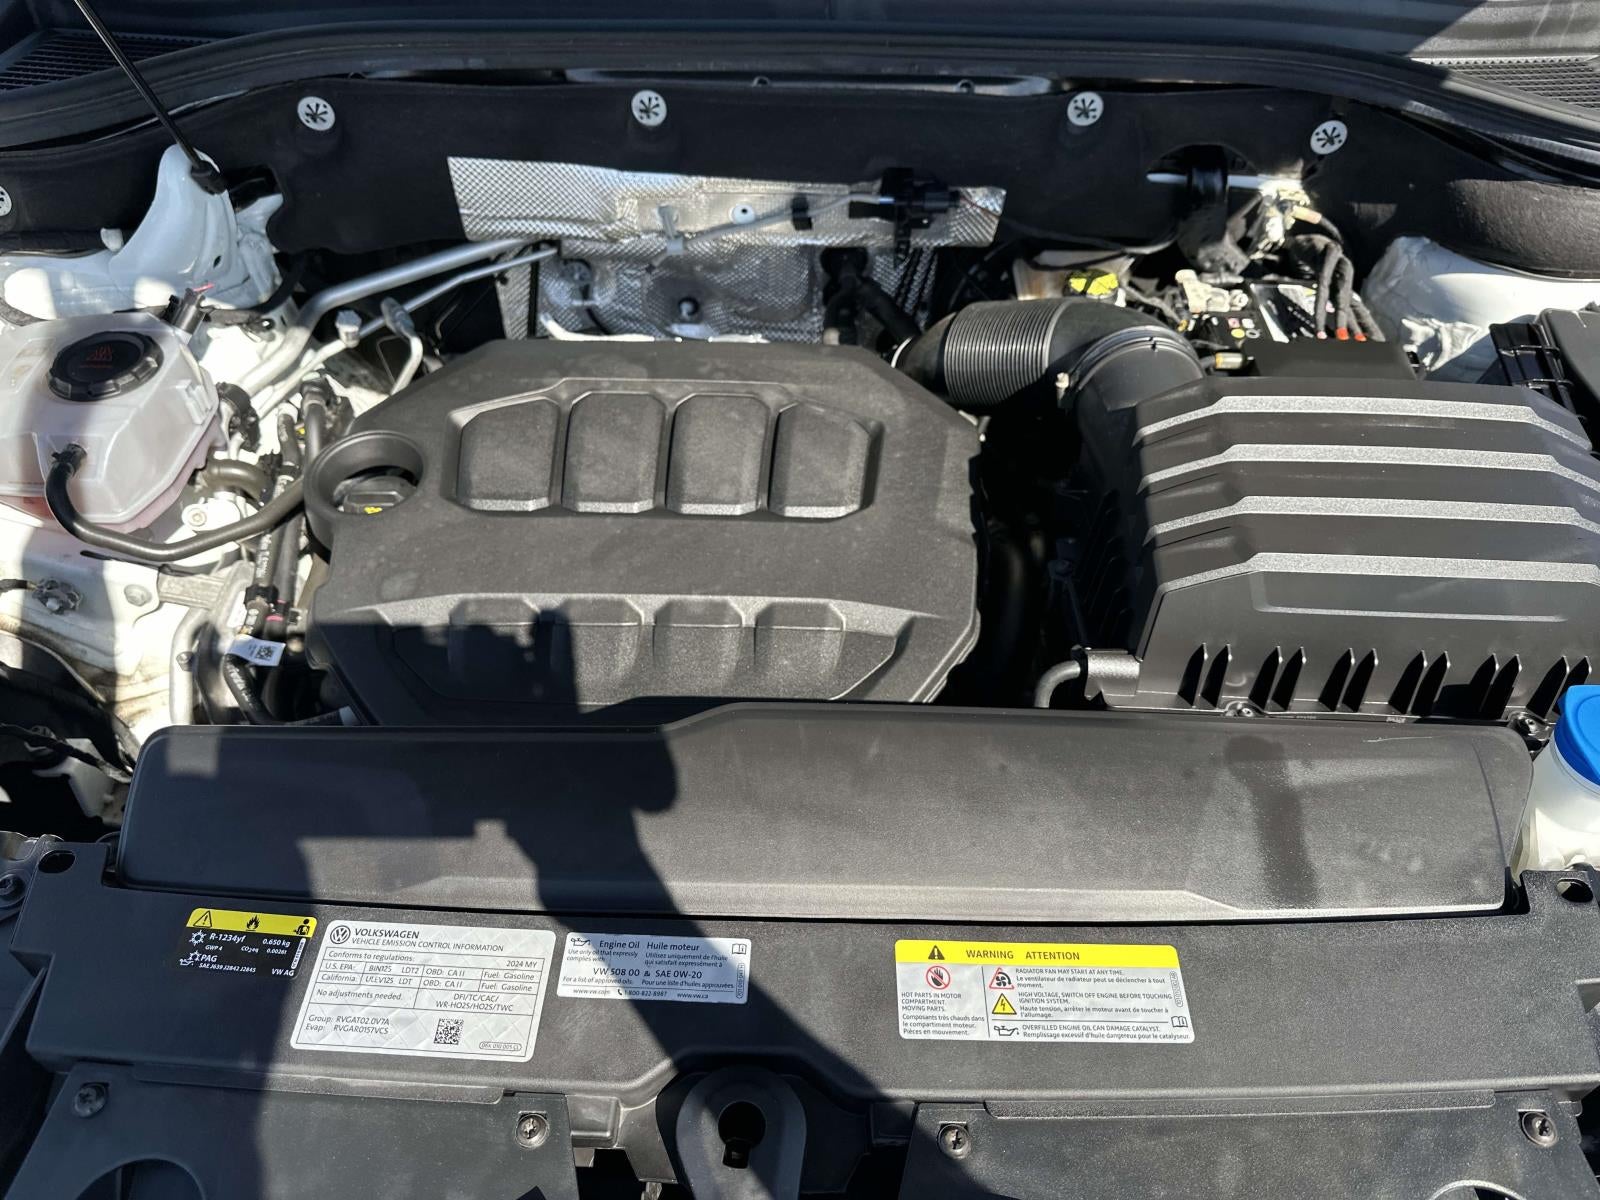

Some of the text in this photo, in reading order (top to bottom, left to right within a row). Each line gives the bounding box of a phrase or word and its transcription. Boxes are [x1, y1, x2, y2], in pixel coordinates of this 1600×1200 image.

[210, 933, 246, 942] R-1234yf
[355, 928, 420, 938] VOLKSWAGEN
[382, 939, 416, 947] EMISSION
[418, 940, 451, 949] CONTROL
[453, 943, 504, 951] INFORMATION
[600, 941, 626, 949] Engine
[373, 953, 415, 962] regulations:
[966, 950, 1080, 960] WARNING ATTENTION
[329, 990, 372, 998] adjustments
[454, 993, 500, 1002] DFI/TC/CAC/
[436, 1001, 513, 1012] WR-HO2S/HO2S/TWC
[336, 1016, 390, 1025] RVGAT02.0V7A
[306, 1024, 325, 1032] Evap:
